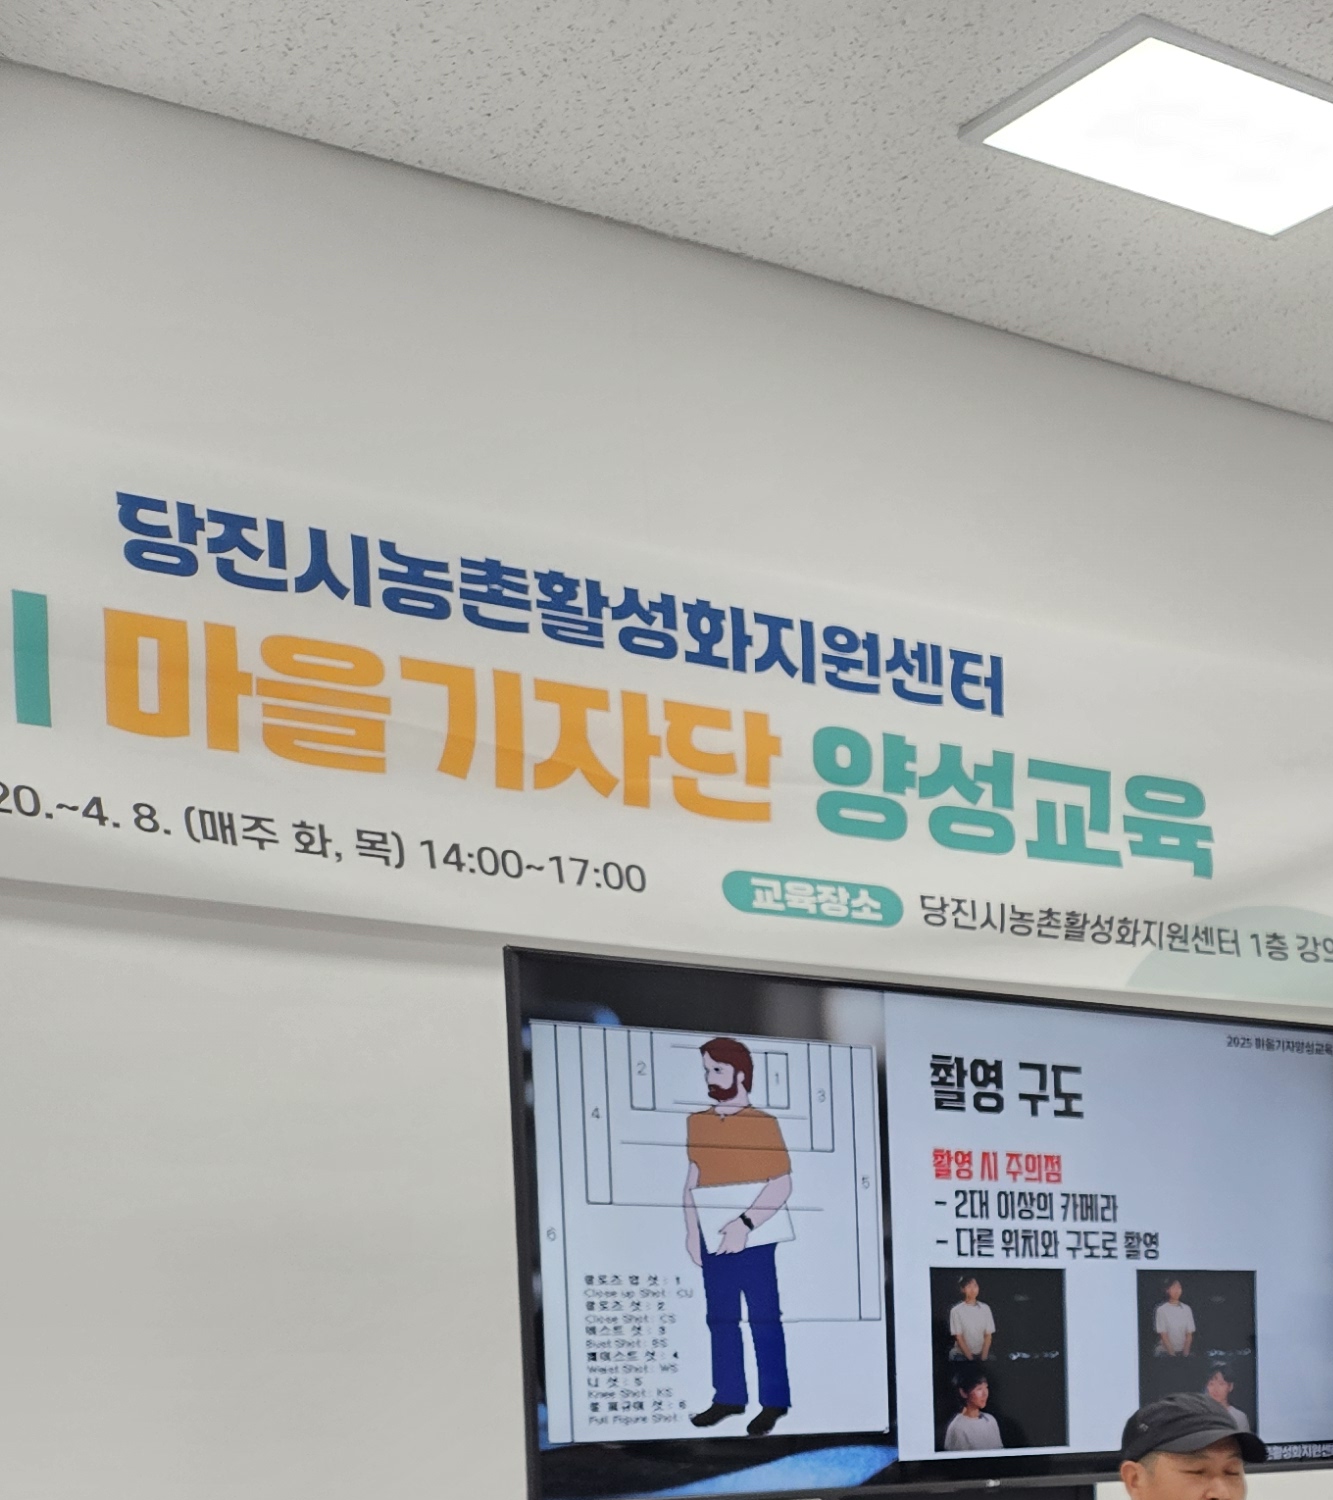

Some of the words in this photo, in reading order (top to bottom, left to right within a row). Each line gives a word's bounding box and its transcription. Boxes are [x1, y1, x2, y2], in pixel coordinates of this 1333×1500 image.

[115, 490, 1005, 716] 당진시농촌활성화지원센터
[103, 606, 783, 823] 마을기자단
[812, 726, 1215, 878] 양성교육
[184, 805, 281, 852] (매주
[292, 818, 344, 864] 화,
[354, 827, 406, 870] 목)
[419, 838, 647, 894] 14:00~17:00
[749, 876, 883, 922] 교육장소
[919, 893, 1241, 957] 당진시농촌활성화지원센터
[1250, 931, 1289, 962] 1층
[1226, 1035, 1252, 1049] 2025
[930, 1053, 1005, 1114] 촬영
[1018, 1062, 1085, 1119] 구도
[932, 1148, 973, 1180] 촬영
[980, 1151, 998, 1182] 시
[1006, 1152, 1063, 1184] 주의점
[955, 1190, 990, 1220] 2대
[997, 1191, 1054, 1221] 이상의
[1061, 1192, 1118, 1223] 카메라
[956, 1228, 995, 1258] 다른
[1001, 1228, 1059, 1259] 위치와
[1066, 1230, 1118, 1259] 구도로
[1123, 1231, 1160, 1260] 촬영
